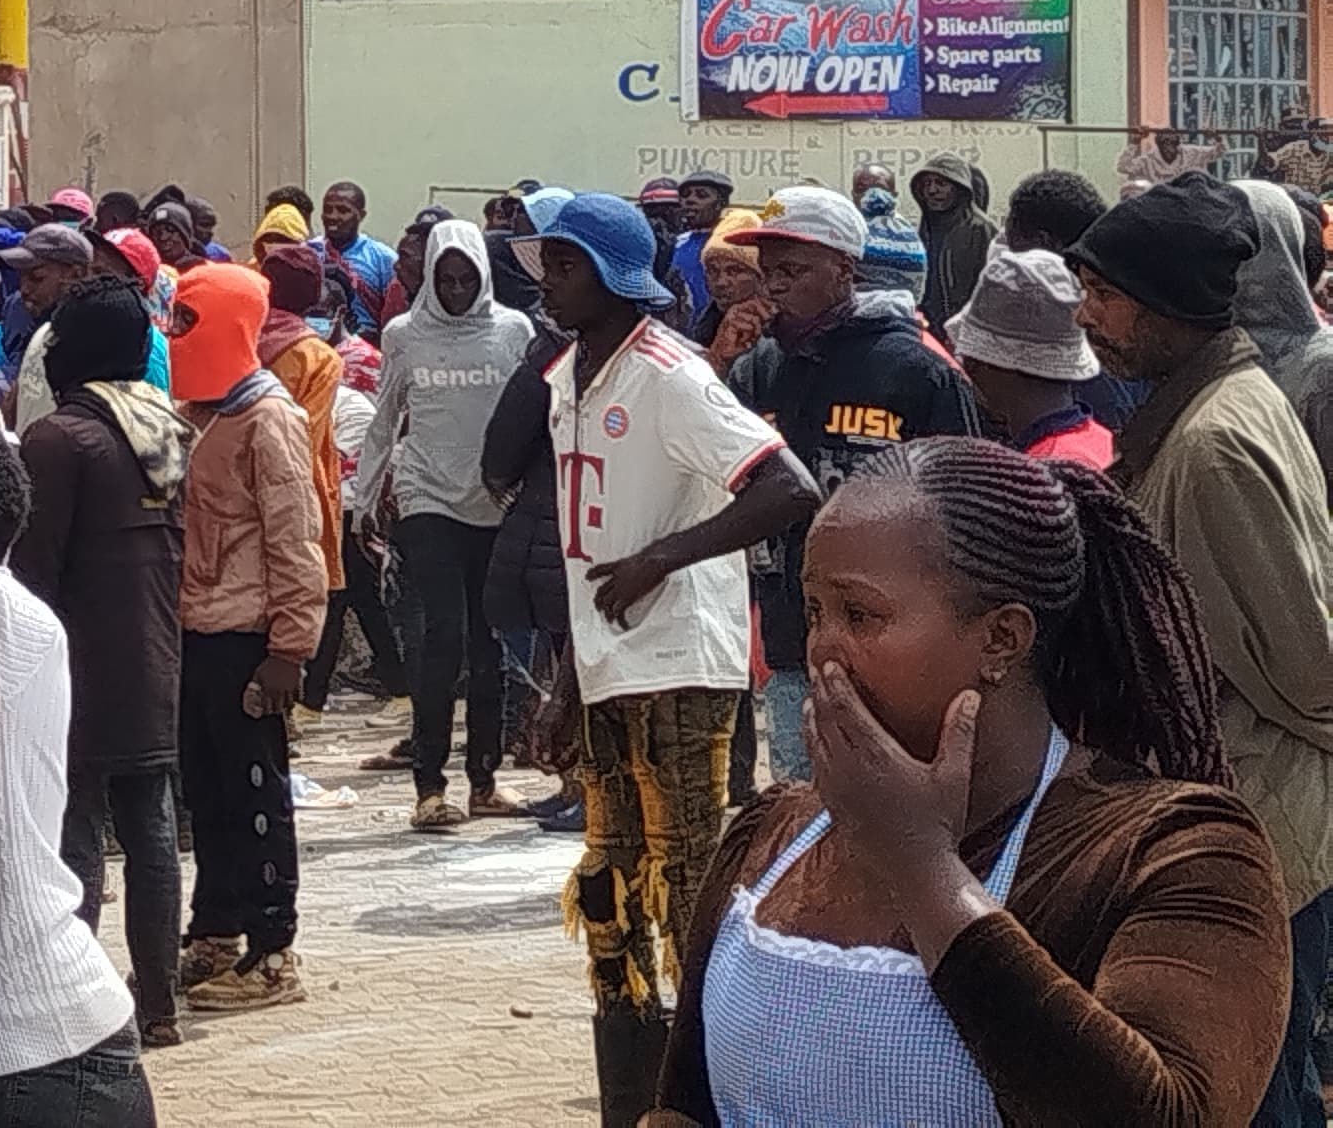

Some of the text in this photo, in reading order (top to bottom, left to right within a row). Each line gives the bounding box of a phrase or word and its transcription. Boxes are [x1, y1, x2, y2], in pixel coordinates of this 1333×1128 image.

[936, 45, 1042, 68] Spare parts
[727, 55, 904, 92] NOW OPEN
[937, 74, 1000, 96] Repair
[637, 147, 800, 177] PUNCTURE
